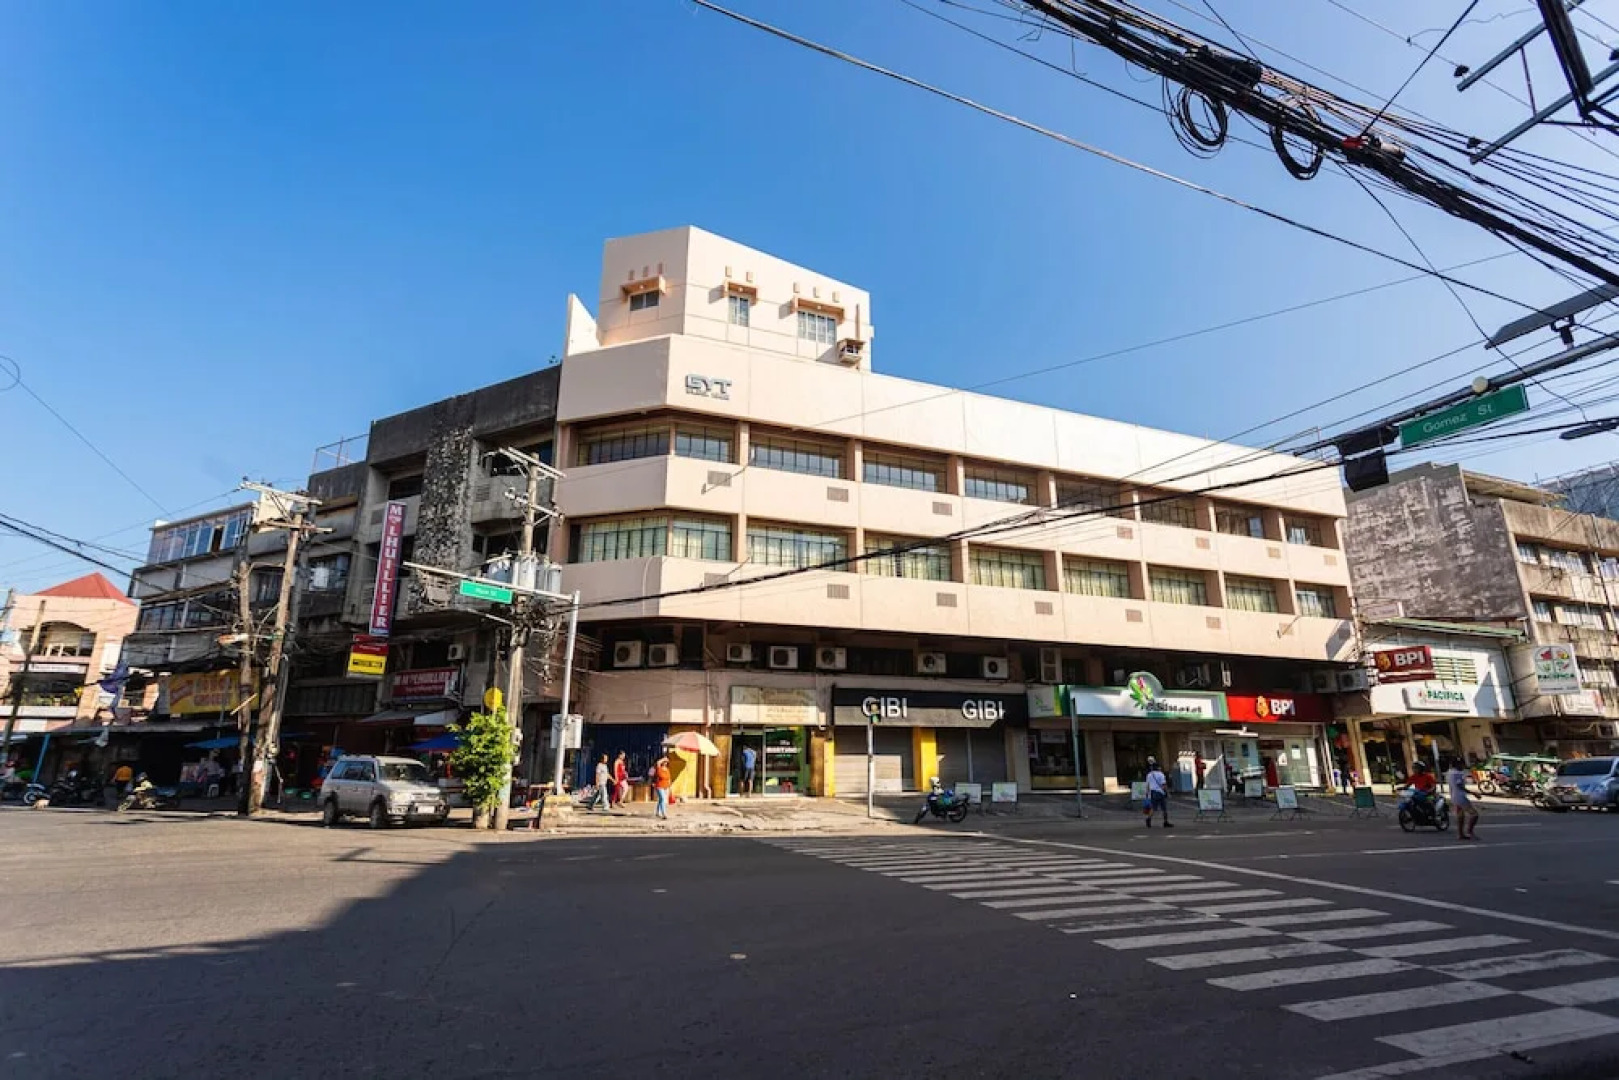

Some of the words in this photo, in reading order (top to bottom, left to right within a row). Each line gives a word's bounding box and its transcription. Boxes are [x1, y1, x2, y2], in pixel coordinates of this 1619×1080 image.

[1422, 413, 1468, 433] Gomez
[1477, 403, 1493, 416] St
[1393, 651, 1425, 666] BPI
[961, 699, 1003, 720] GIBI
[1270, 698, 1296, 716] BPI
